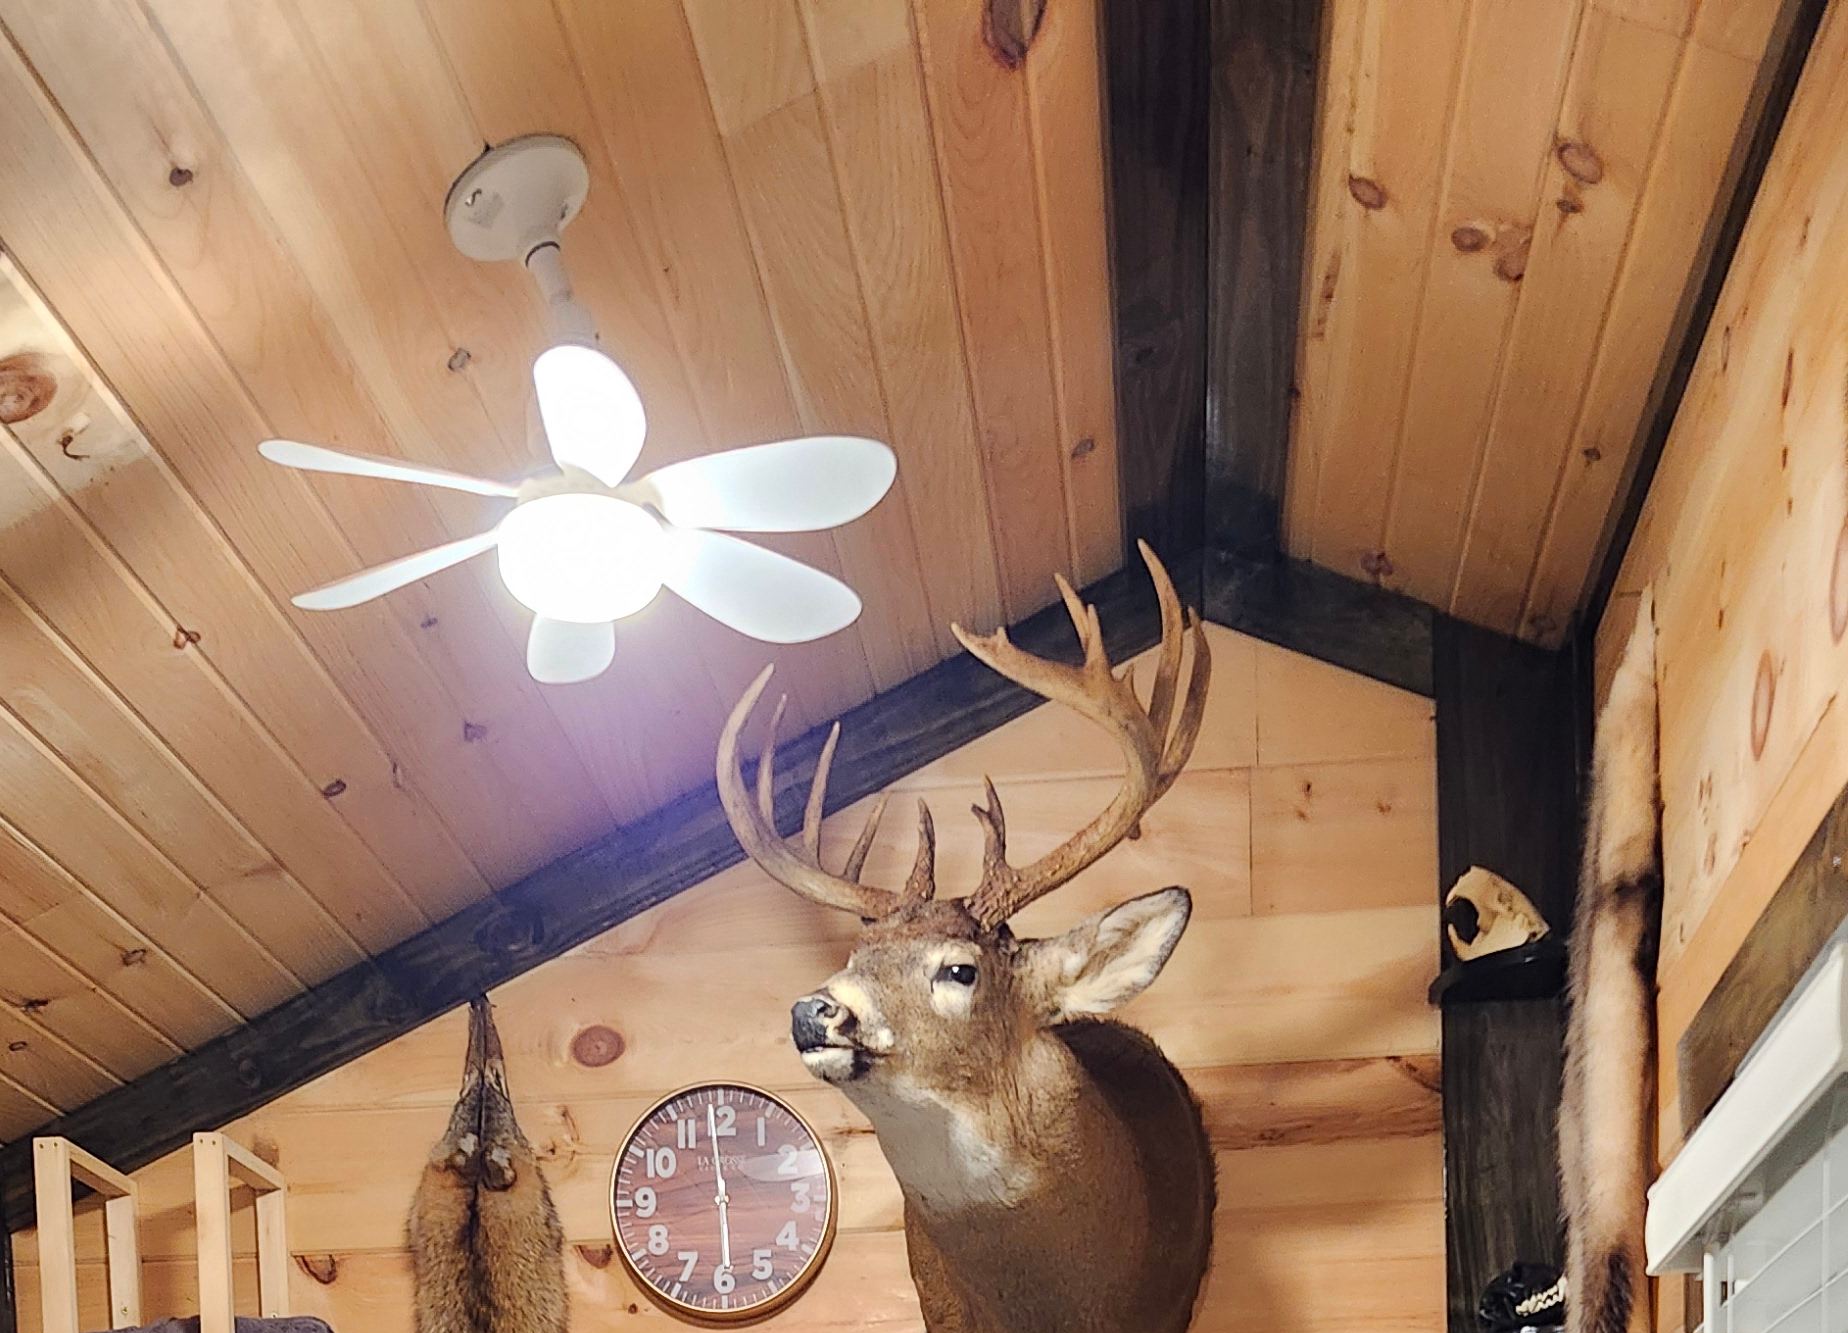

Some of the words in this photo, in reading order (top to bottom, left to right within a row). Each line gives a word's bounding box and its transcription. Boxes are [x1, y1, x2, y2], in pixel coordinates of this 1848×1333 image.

[678, 1119, 697, 1149] 11
[707, 1105, 736, 1137] 12
[757, 1117, 766, 1146] 1
[646, 1147, 677, 1178] 10
[777, 1144, 798, 1175] 2
[634, 1187, 657, 1218] 9
[791, 1182, 811, 1213] 3
[648, 1224, 670, 1255] 8
[775, 1221, 800, 1250] 4
[677, 1252, 699, 1282] 7
[713, 1264, 736, 1294] 6
[751, 1249, 773, 1280] 5
